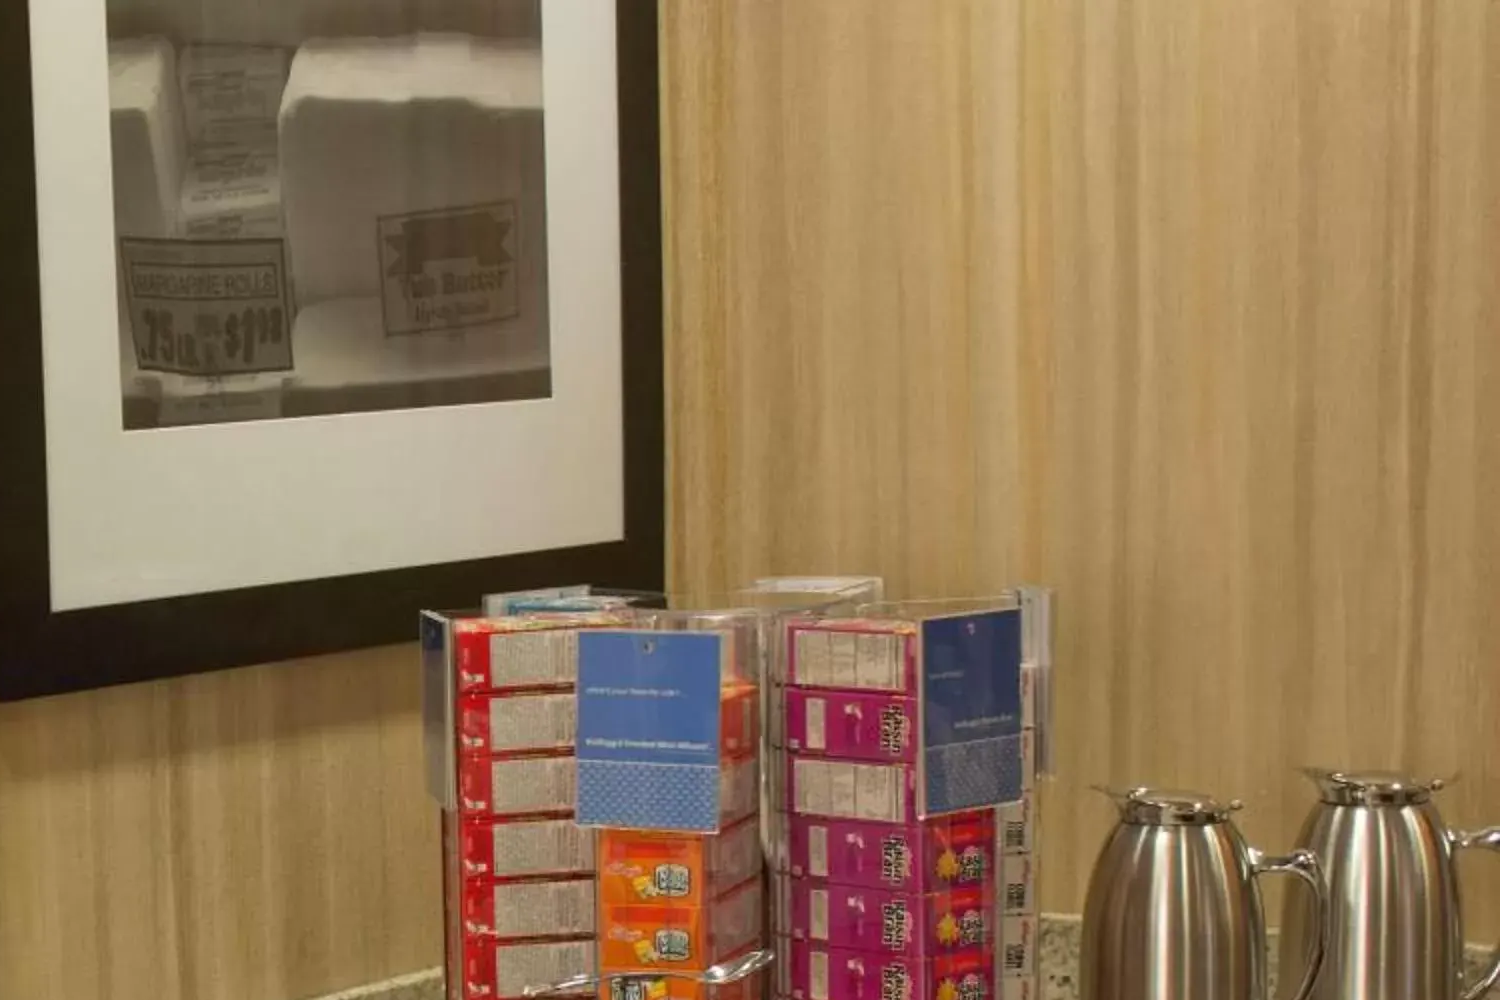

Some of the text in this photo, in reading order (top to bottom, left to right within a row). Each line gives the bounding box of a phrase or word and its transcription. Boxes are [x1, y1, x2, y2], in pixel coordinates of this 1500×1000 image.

[890, 704, 904, 755] Raisin
[891, 835, 904, 886] Raisin
[892, 900, 905, 950] Raisin
